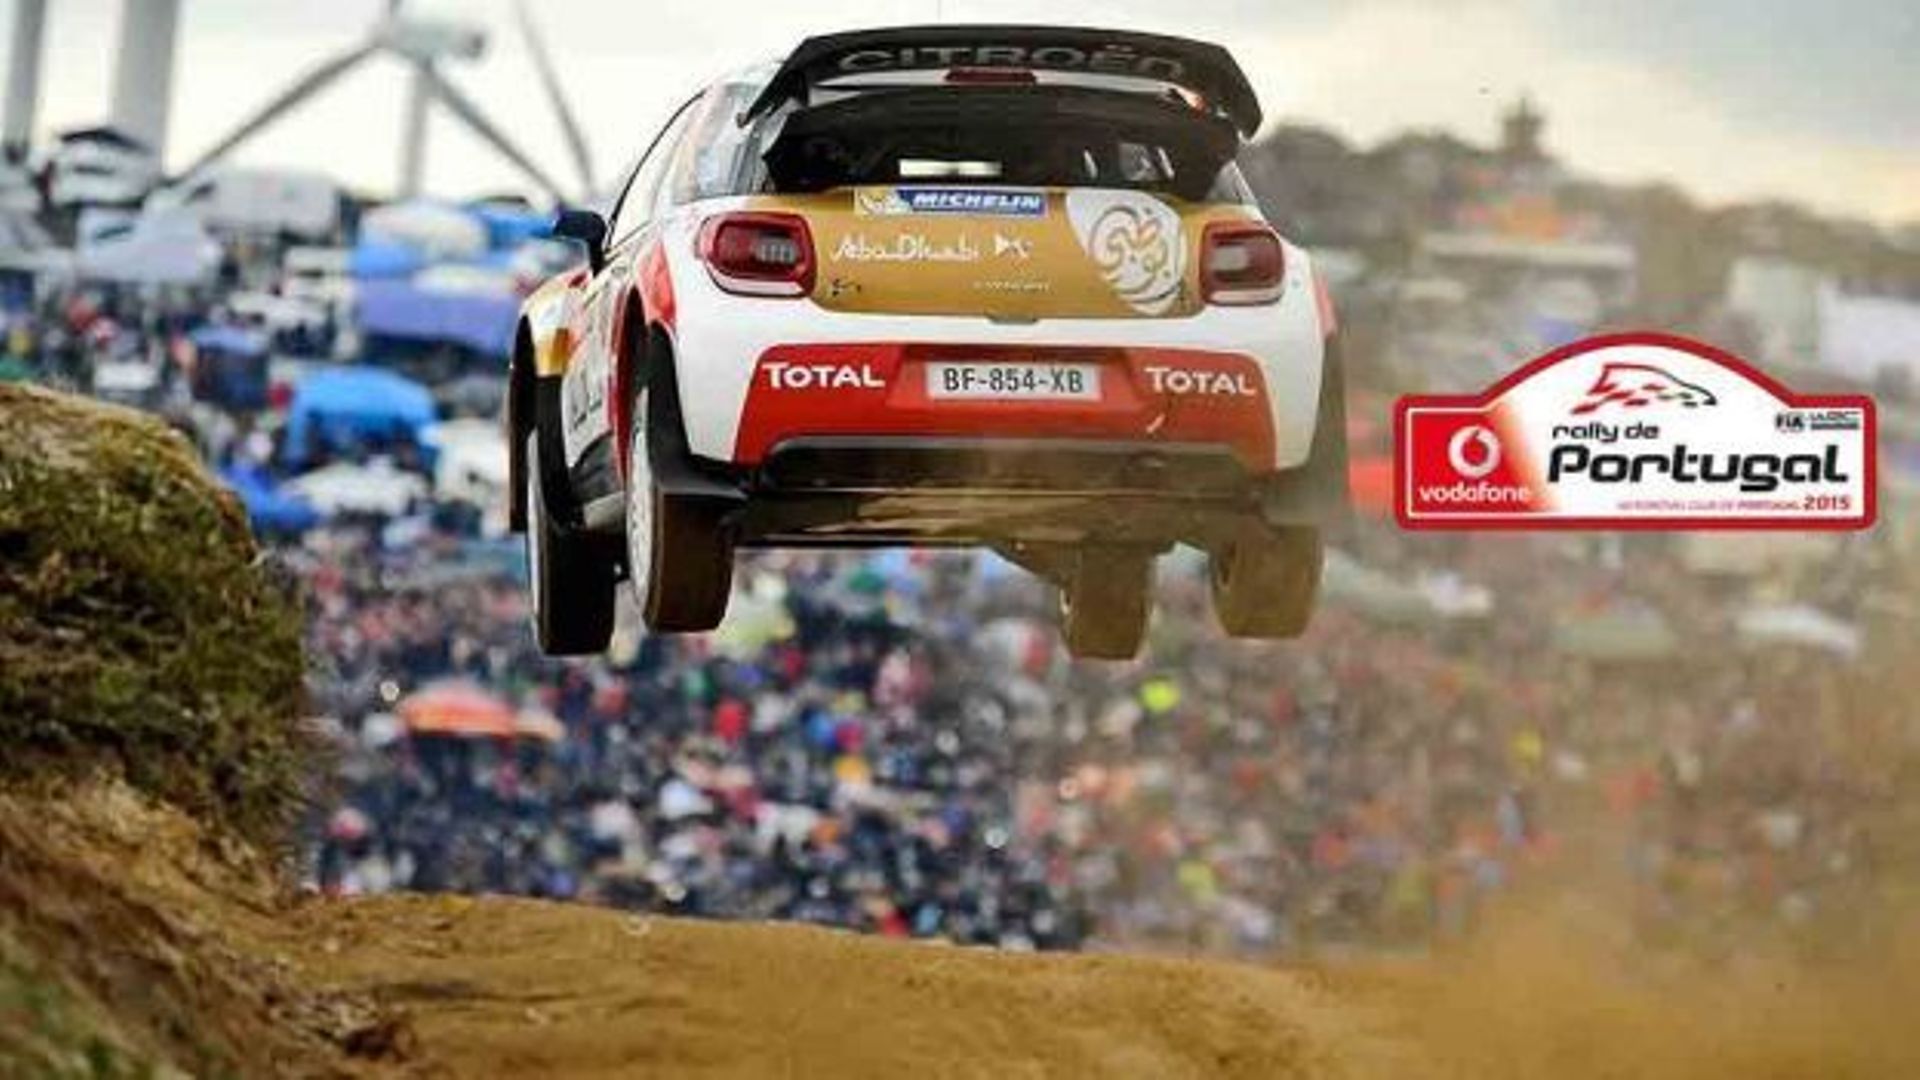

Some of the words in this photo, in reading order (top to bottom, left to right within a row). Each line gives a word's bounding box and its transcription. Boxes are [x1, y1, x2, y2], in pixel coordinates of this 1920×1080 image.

[913, 193, 1042, 210] MICHELIN
[766, 362, 885, 389] TOTAL
[942, 367, 1083, 393] BF-854-XB
[1145, 367, 1257, 396] TOTAL
